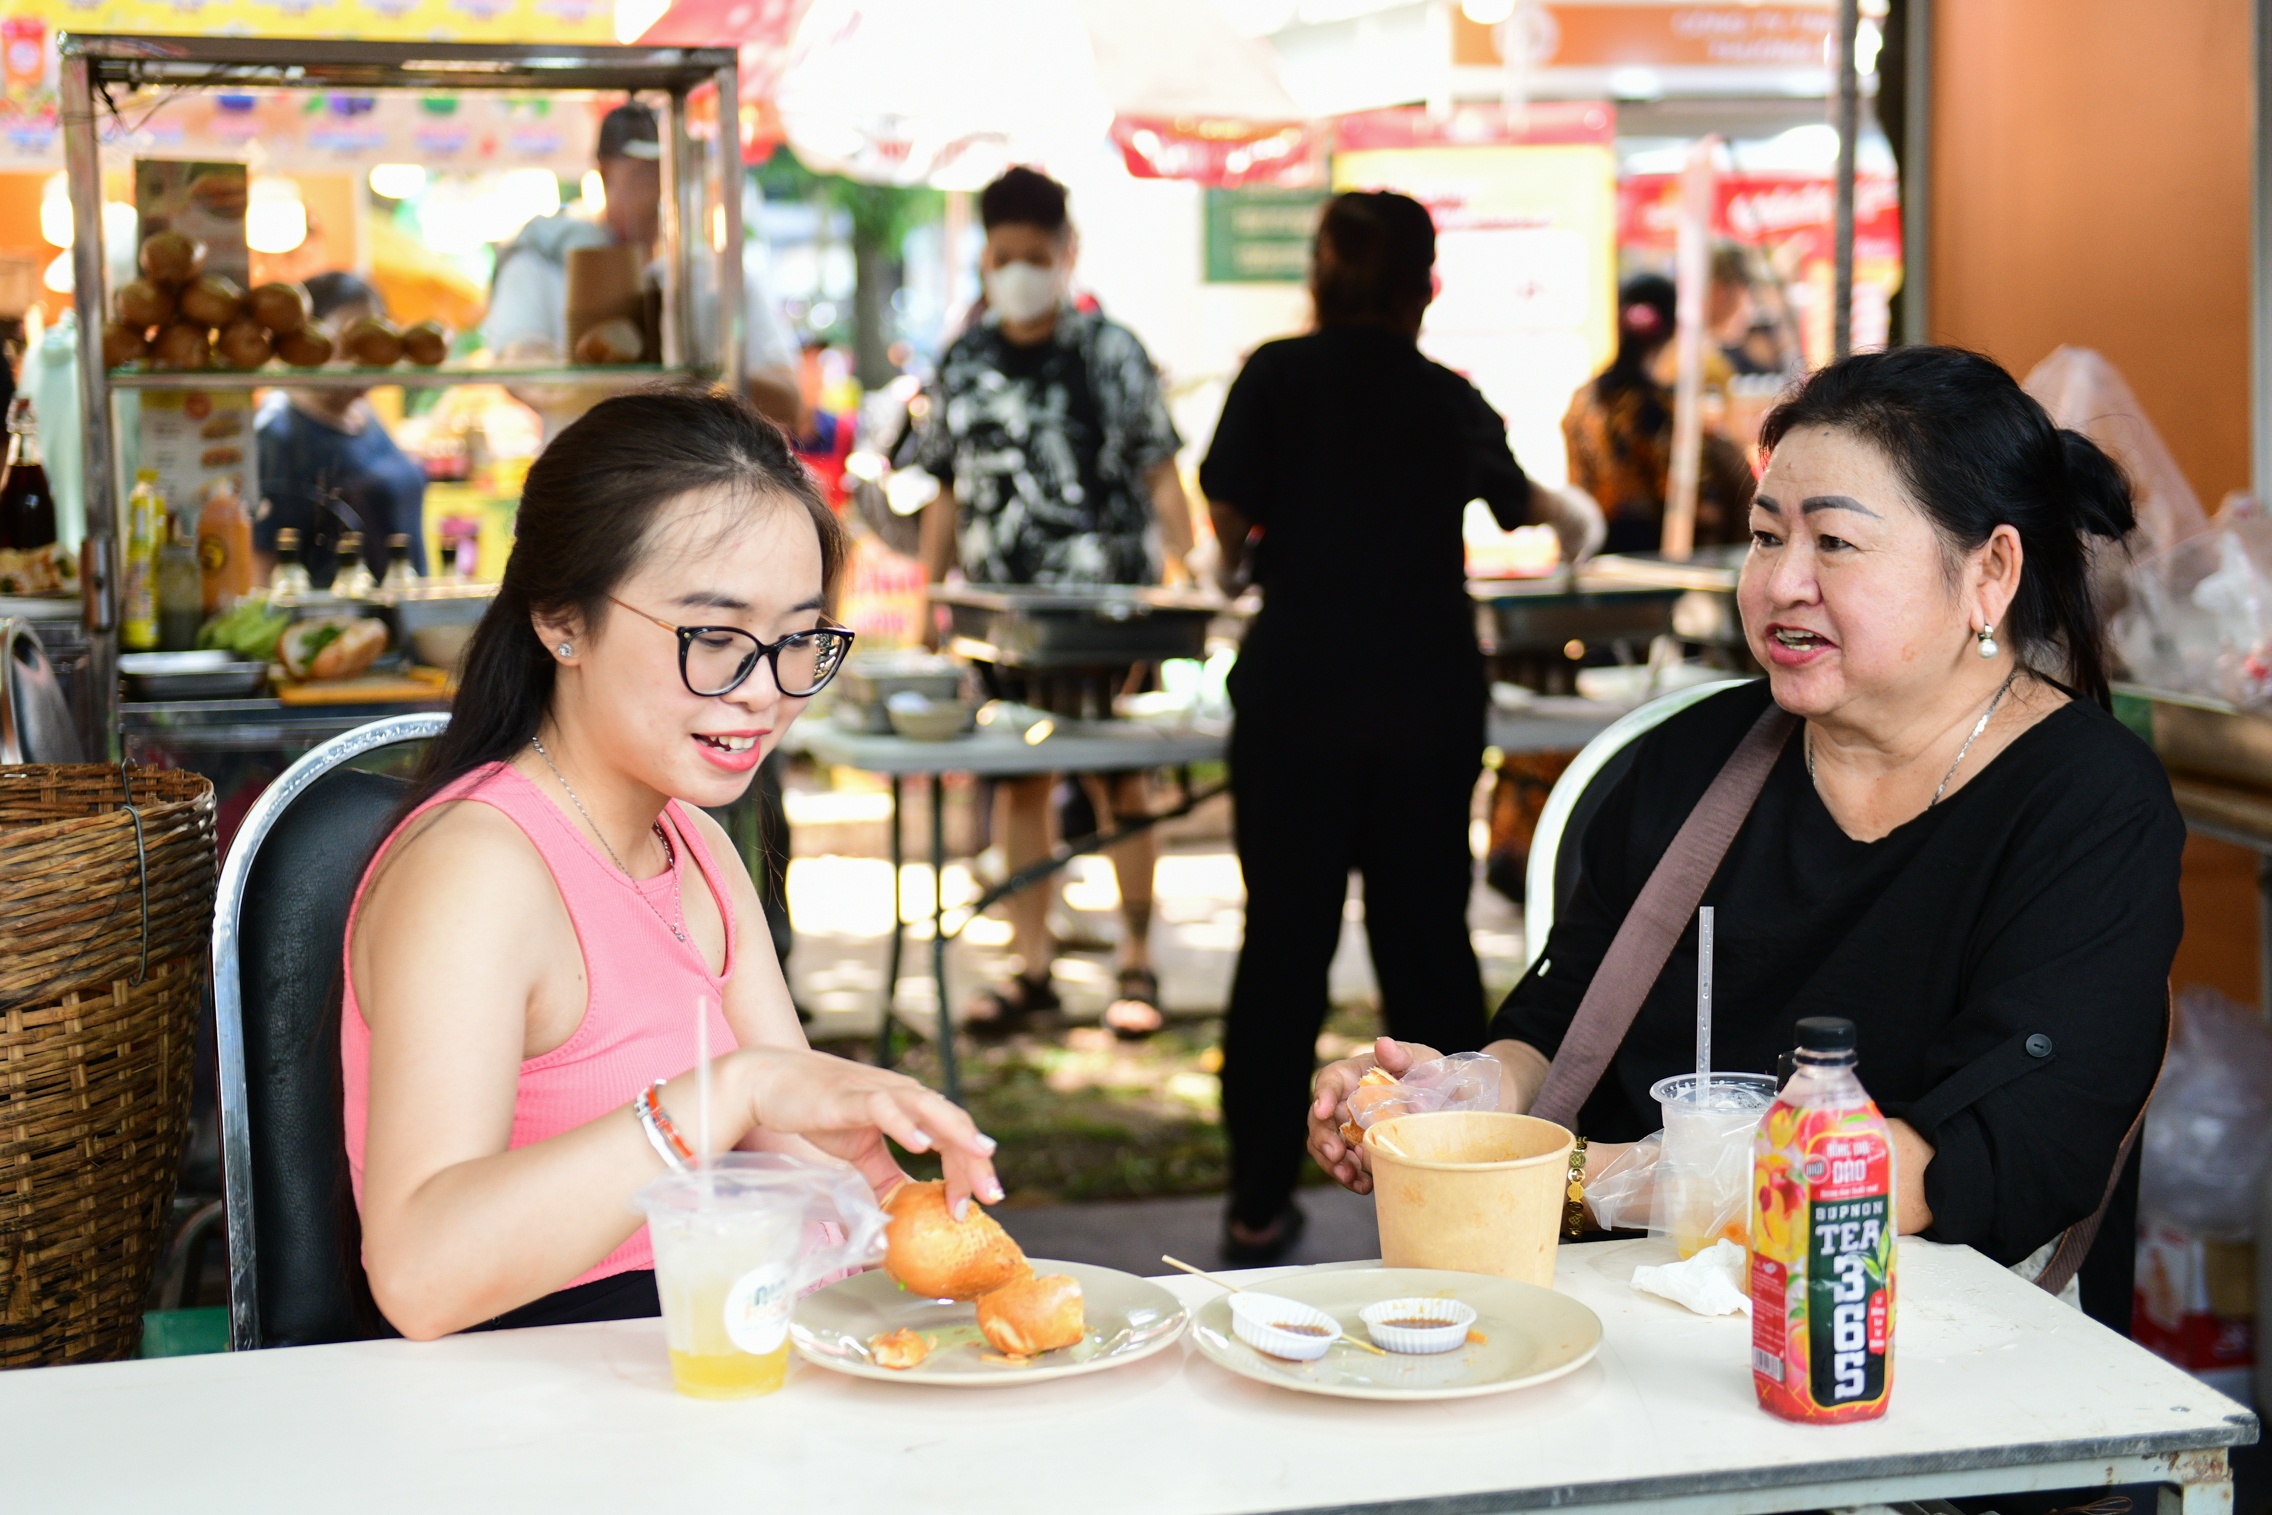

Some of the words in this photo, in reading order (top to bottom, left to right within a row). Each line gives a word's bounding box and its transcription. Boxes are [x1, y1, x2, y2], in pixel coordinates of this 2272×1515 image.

[1815, 1201, 1883, 1221] BUPNON
[1815, 1219, 1880, 1255] TEA
[1833, 1254, 1866, 1400] 365
